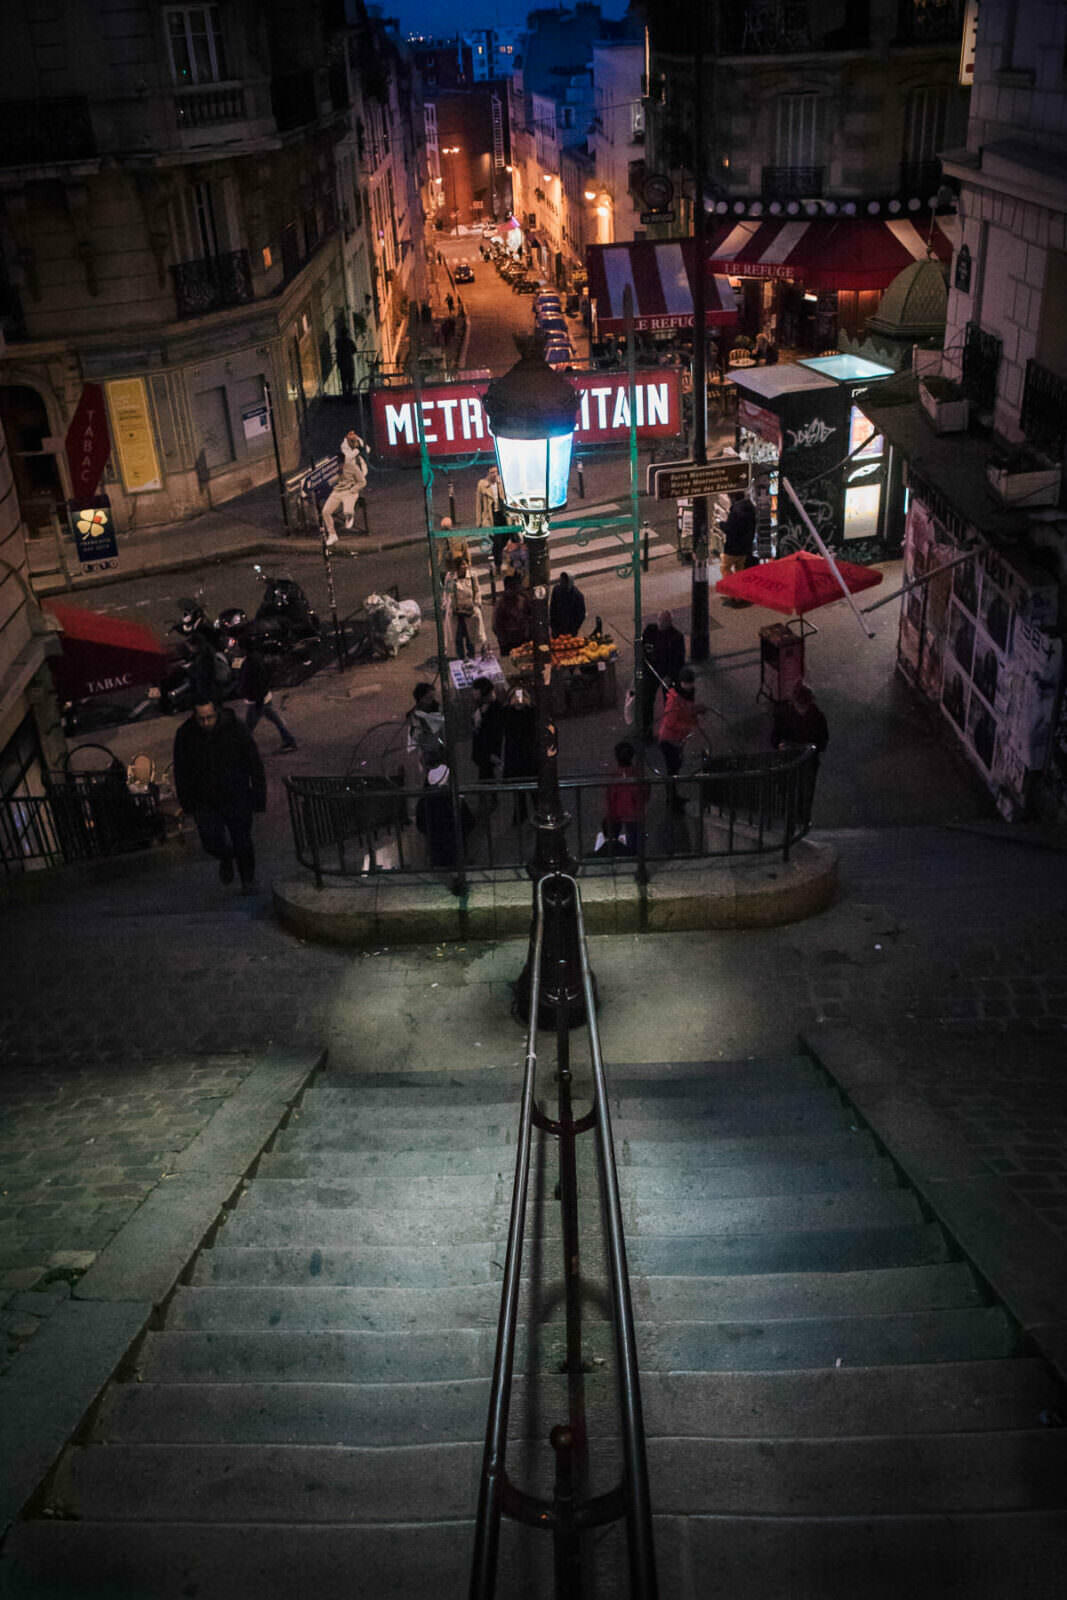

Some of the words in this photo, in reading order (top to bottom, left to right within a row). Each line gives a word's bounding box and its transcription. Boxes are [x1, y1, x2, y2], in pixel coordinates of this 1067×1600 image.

[725, 263, 741, 275] LE
[743, 263, 794, 279] REFUGE
[651, 315, 695, 329] REFUG
[384, 383, 669, 446] METRITAIN
[81, 409, 96, 482] TABAC
[86, 673, 132, 693] TABAC
